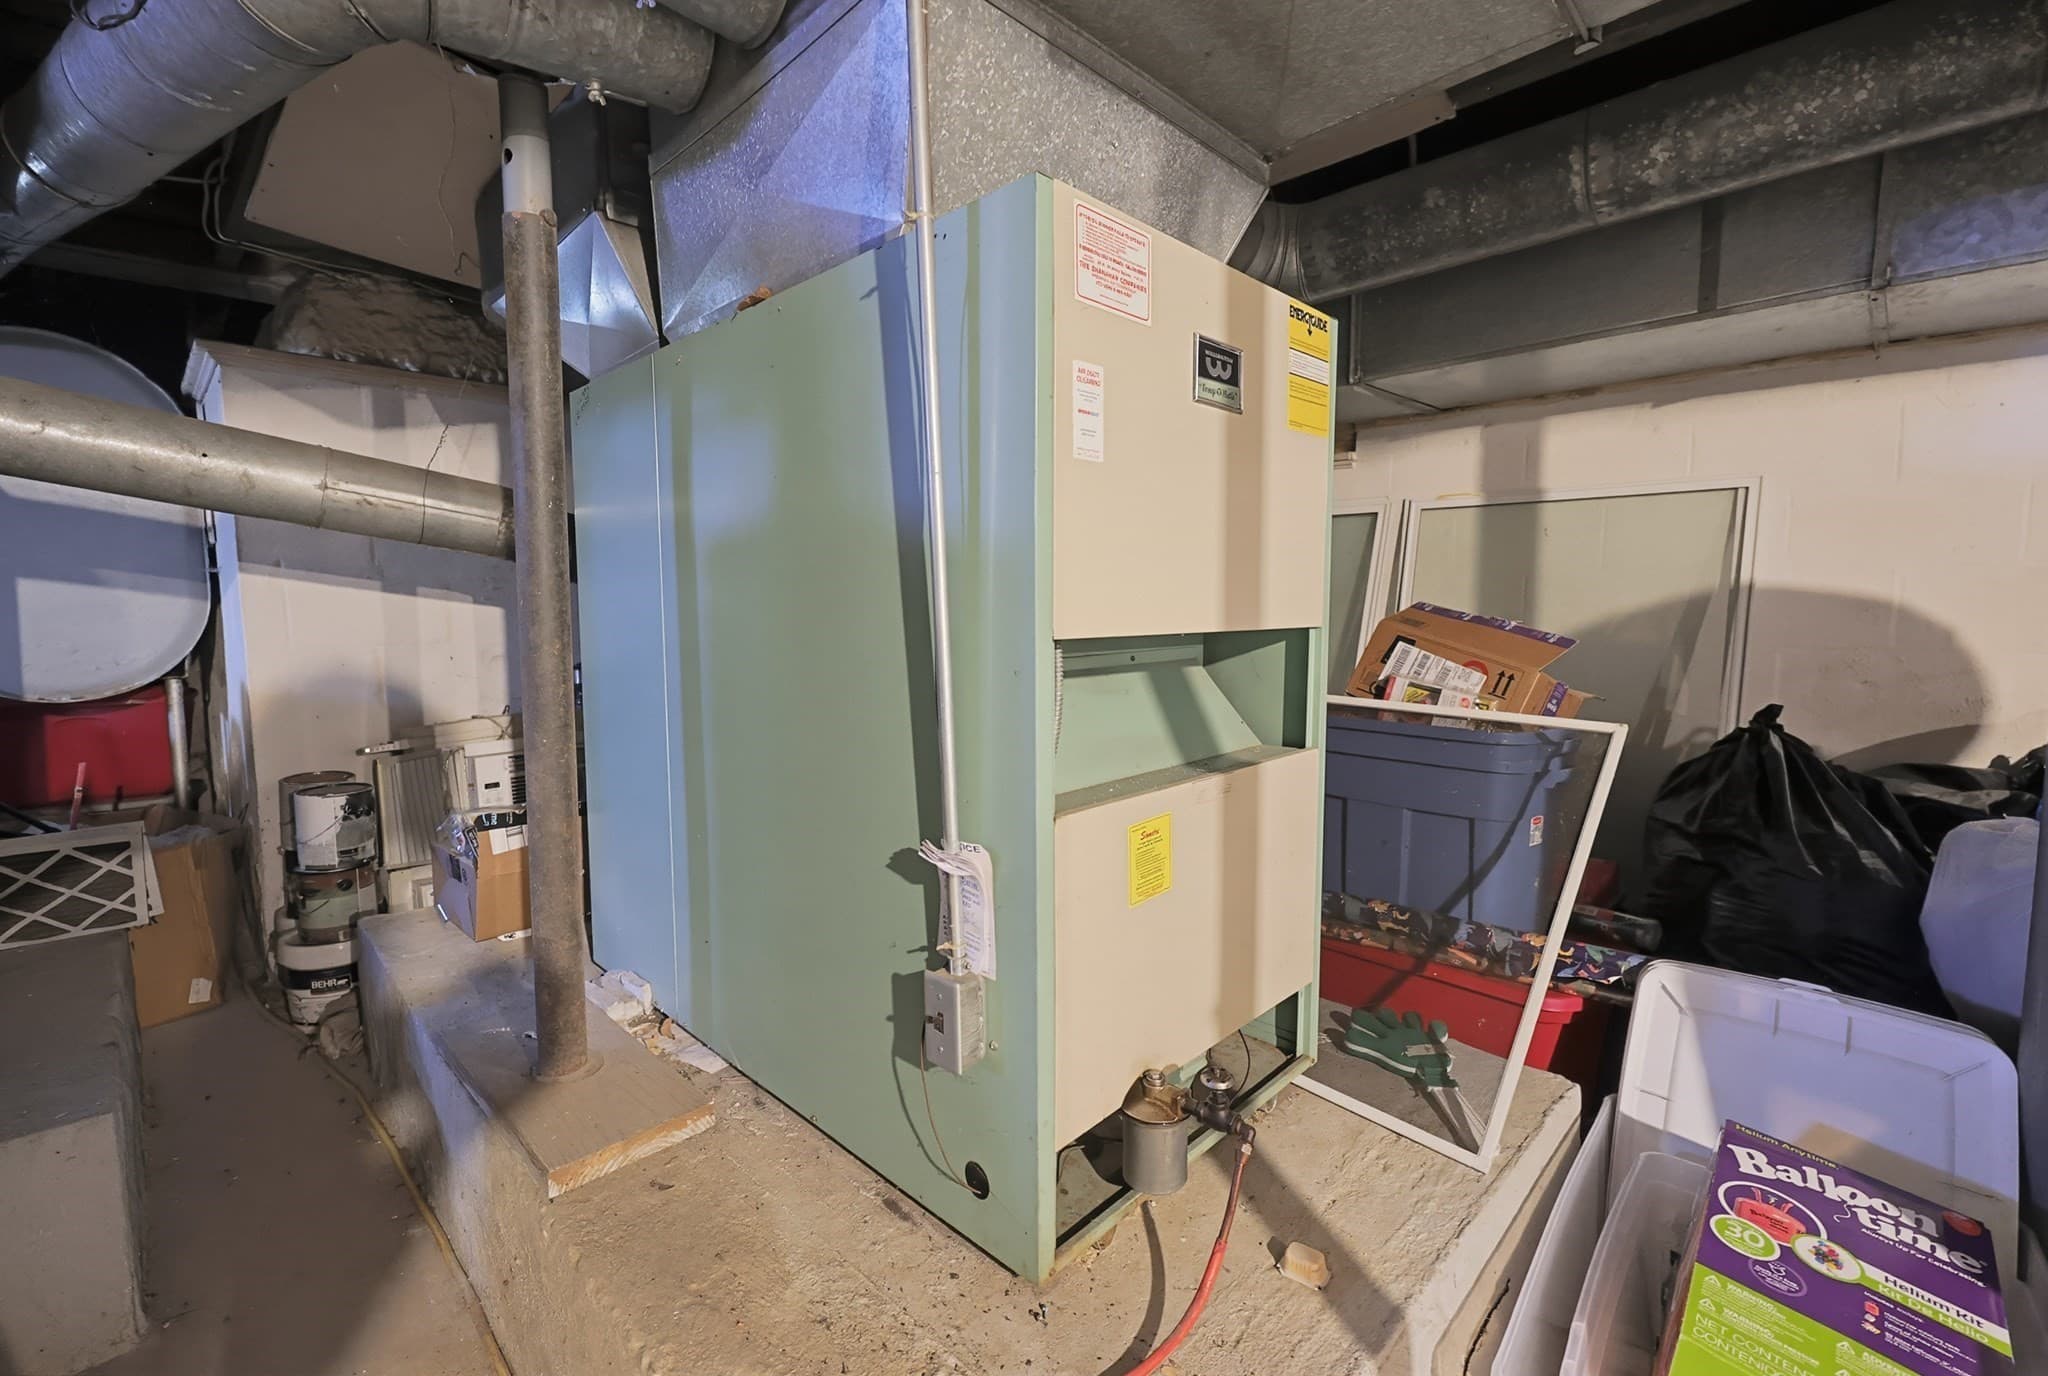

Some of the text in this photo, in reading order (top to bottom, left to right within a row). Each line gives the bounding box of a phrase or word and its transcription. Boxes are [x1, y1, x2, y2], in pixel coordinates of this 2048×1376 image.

[311, 978, 337, 990] BEHR
[1735, 1123, 1779, 1146] Helium
[1726, 1143, 1940, 1239] Balloon
[1724, 1220, 1765, 1249] 30
[1850, 1207, 1984, 1274] time
[1878, 1283, 1904, 1302] Kit
[1907, 1298, 1933, 1319] De
[1938, 1313, 1989, 1345] Helio
[1884, 1275, 1985, 1330] Helium Kit
[1694, 1313, 1729, 1336] NET
